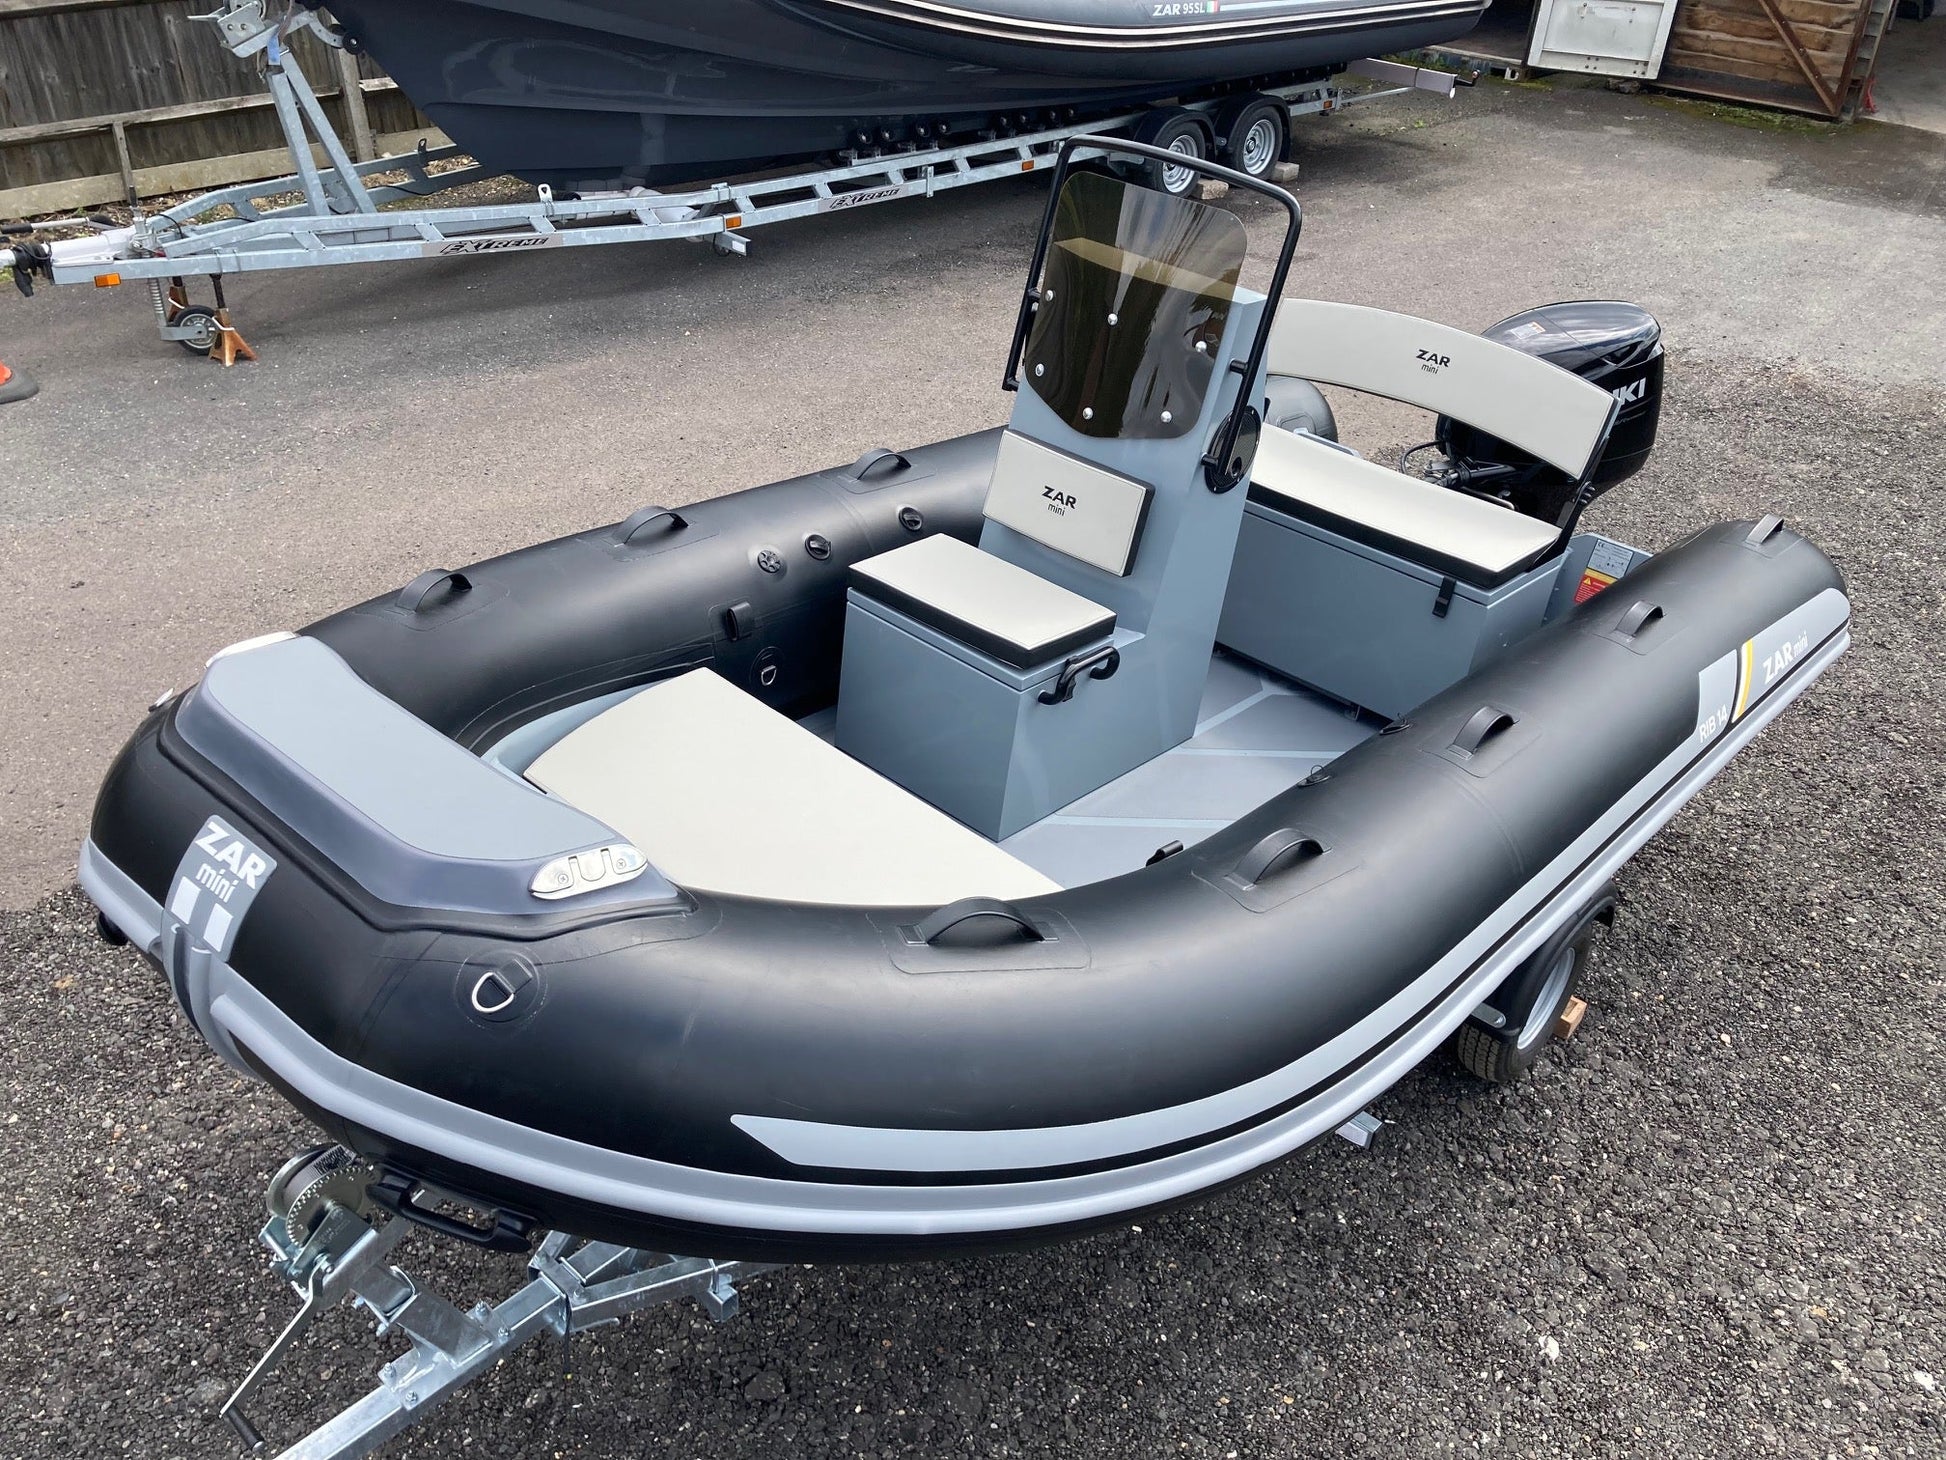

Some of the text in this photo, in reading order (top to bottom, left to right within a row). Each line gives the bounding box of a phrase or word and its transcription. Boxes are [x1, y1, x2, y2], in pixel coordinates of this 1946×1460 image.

[1153, 4, 1205, 17] ZAR 95SL
[829, 188, 900, 209] EXTREME
[440, 237, 549, 255] EXTREME
[1416, 348, 1450, 368] ZAR
[1421, 363, 1439, 375] mini
[1042, 485, 1077, 509] ZAR
[1047, 503, 1066, 516] mini
[1763, 630, 1809, 685] ZAR mini
[1699, 714, 1717, 743] RIB
[195, 821, 266, 890] ZAR
[195, 863, 240, 903] mini
